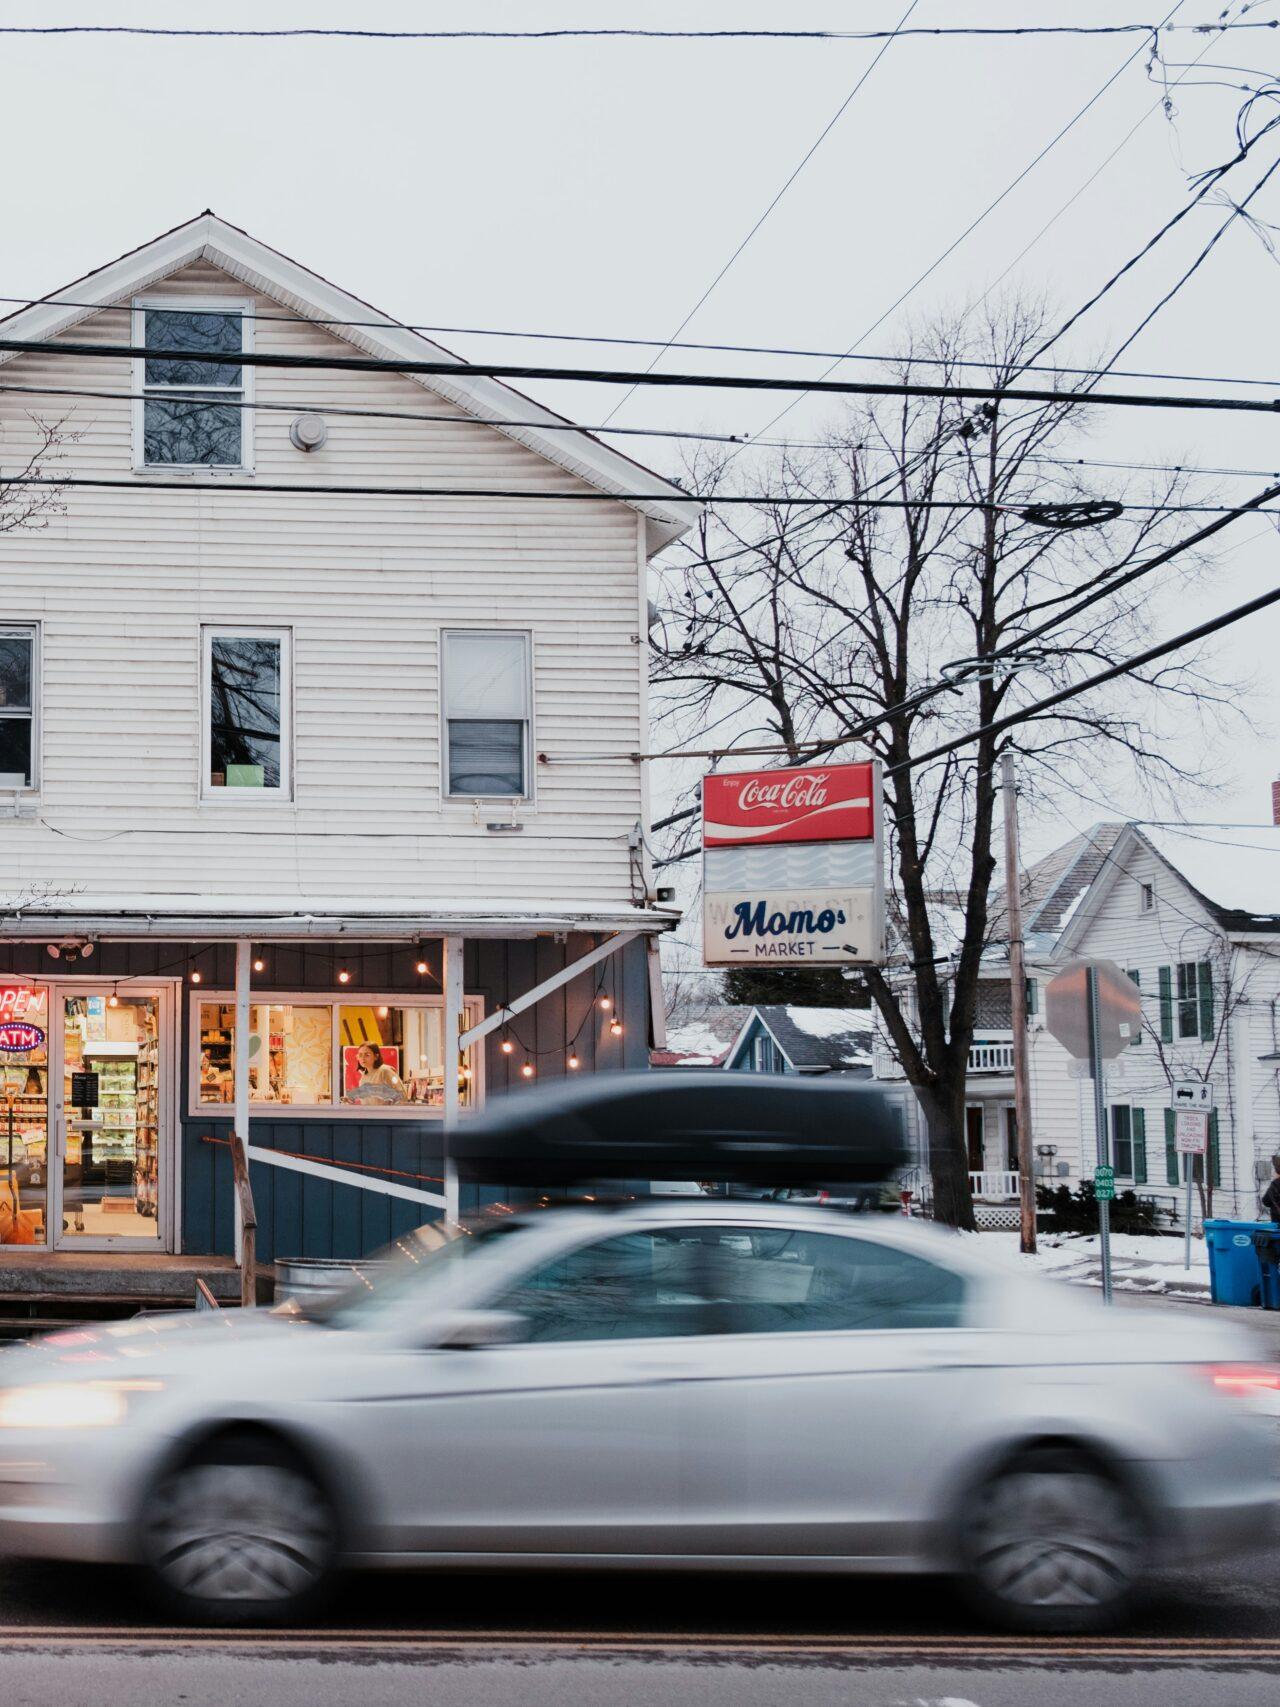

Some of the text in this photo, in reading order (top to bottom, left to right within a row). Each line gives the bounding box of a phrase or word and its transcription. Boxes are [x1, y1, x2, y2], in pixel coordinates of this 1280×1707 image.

[722, 778, 740, 788] Enjoy
[738, 773, 831, 811] Coca-Cola
[725, 901, 847, 940] Momos
[755, 942, 815, 957] MARKET
